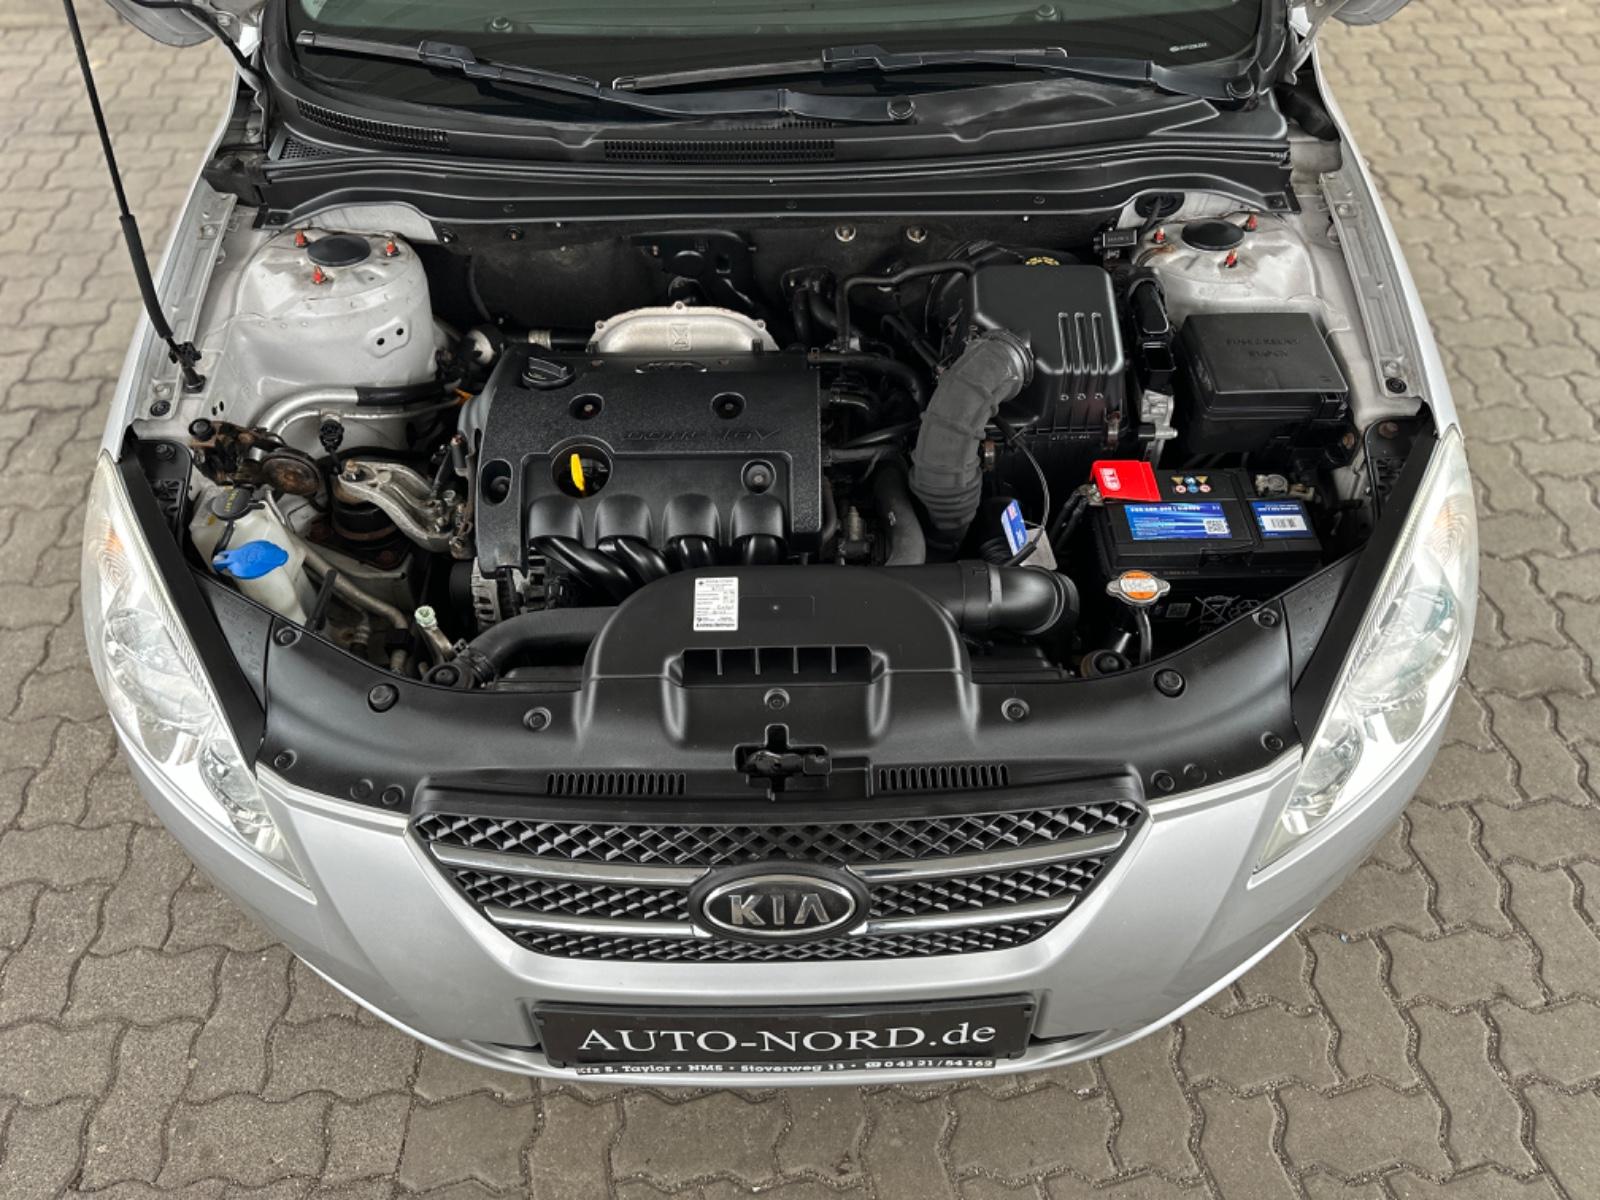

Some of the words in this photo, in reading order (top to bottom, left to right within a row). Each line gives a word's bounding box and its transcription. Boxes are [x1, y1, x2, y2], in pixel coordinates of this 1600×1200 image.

[727, 892, 831, 926] KIA
[577, 1022, 997, 1053] AUTO-NORD.de
[621, 1064, 672, 1073] Taylor
[740, 1064, 823, 1073] Stoverweg
